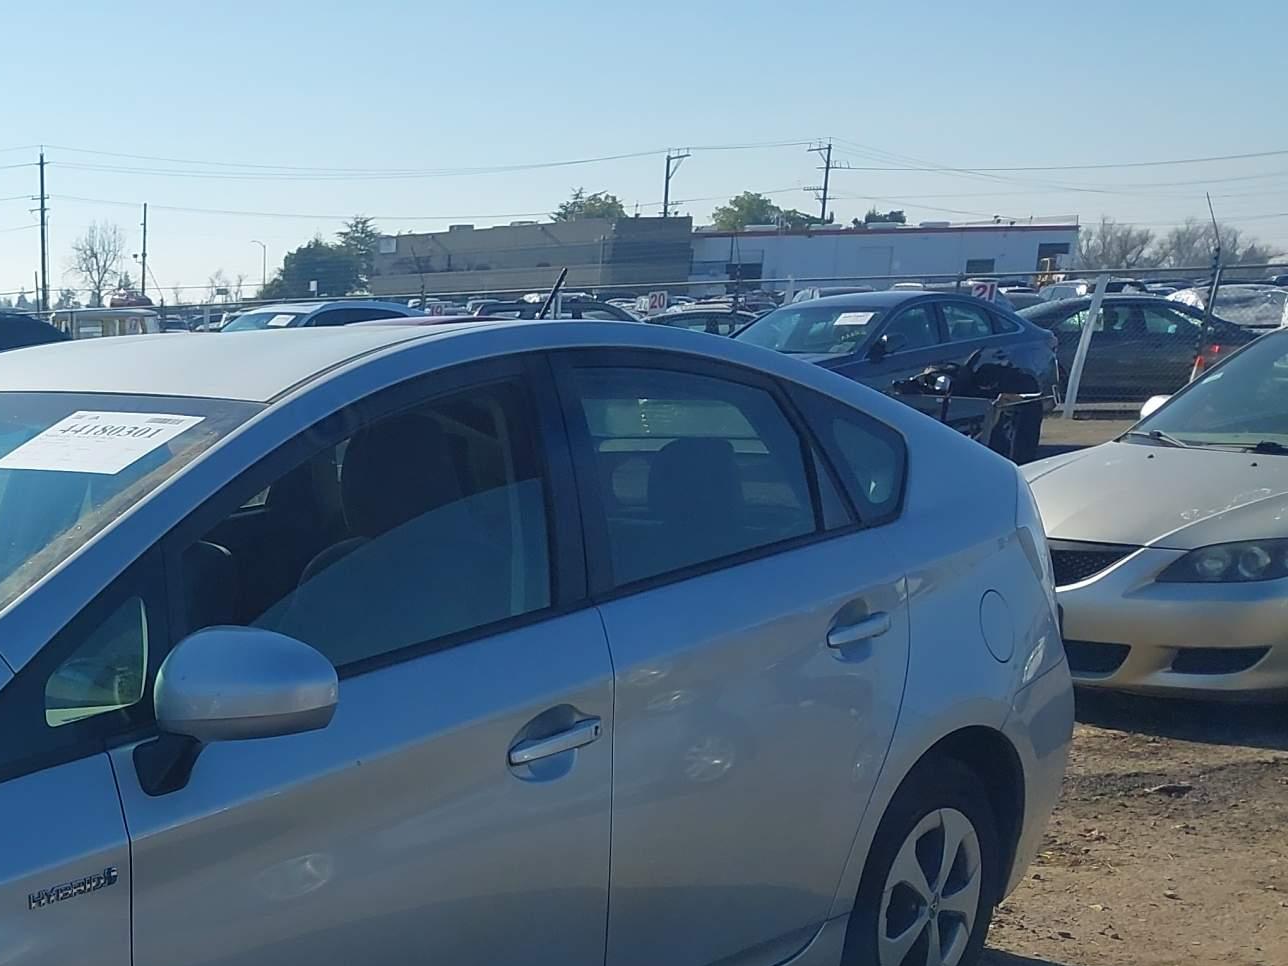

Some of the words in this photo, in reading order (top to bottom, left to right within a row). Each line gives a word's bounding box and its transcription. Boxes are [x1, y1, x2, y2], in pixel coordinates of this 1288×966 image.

[650, 293, 665, 309] 20
[59, 423, 164, 439] 44180301
[28, 873, 106, 910] HYBRID
